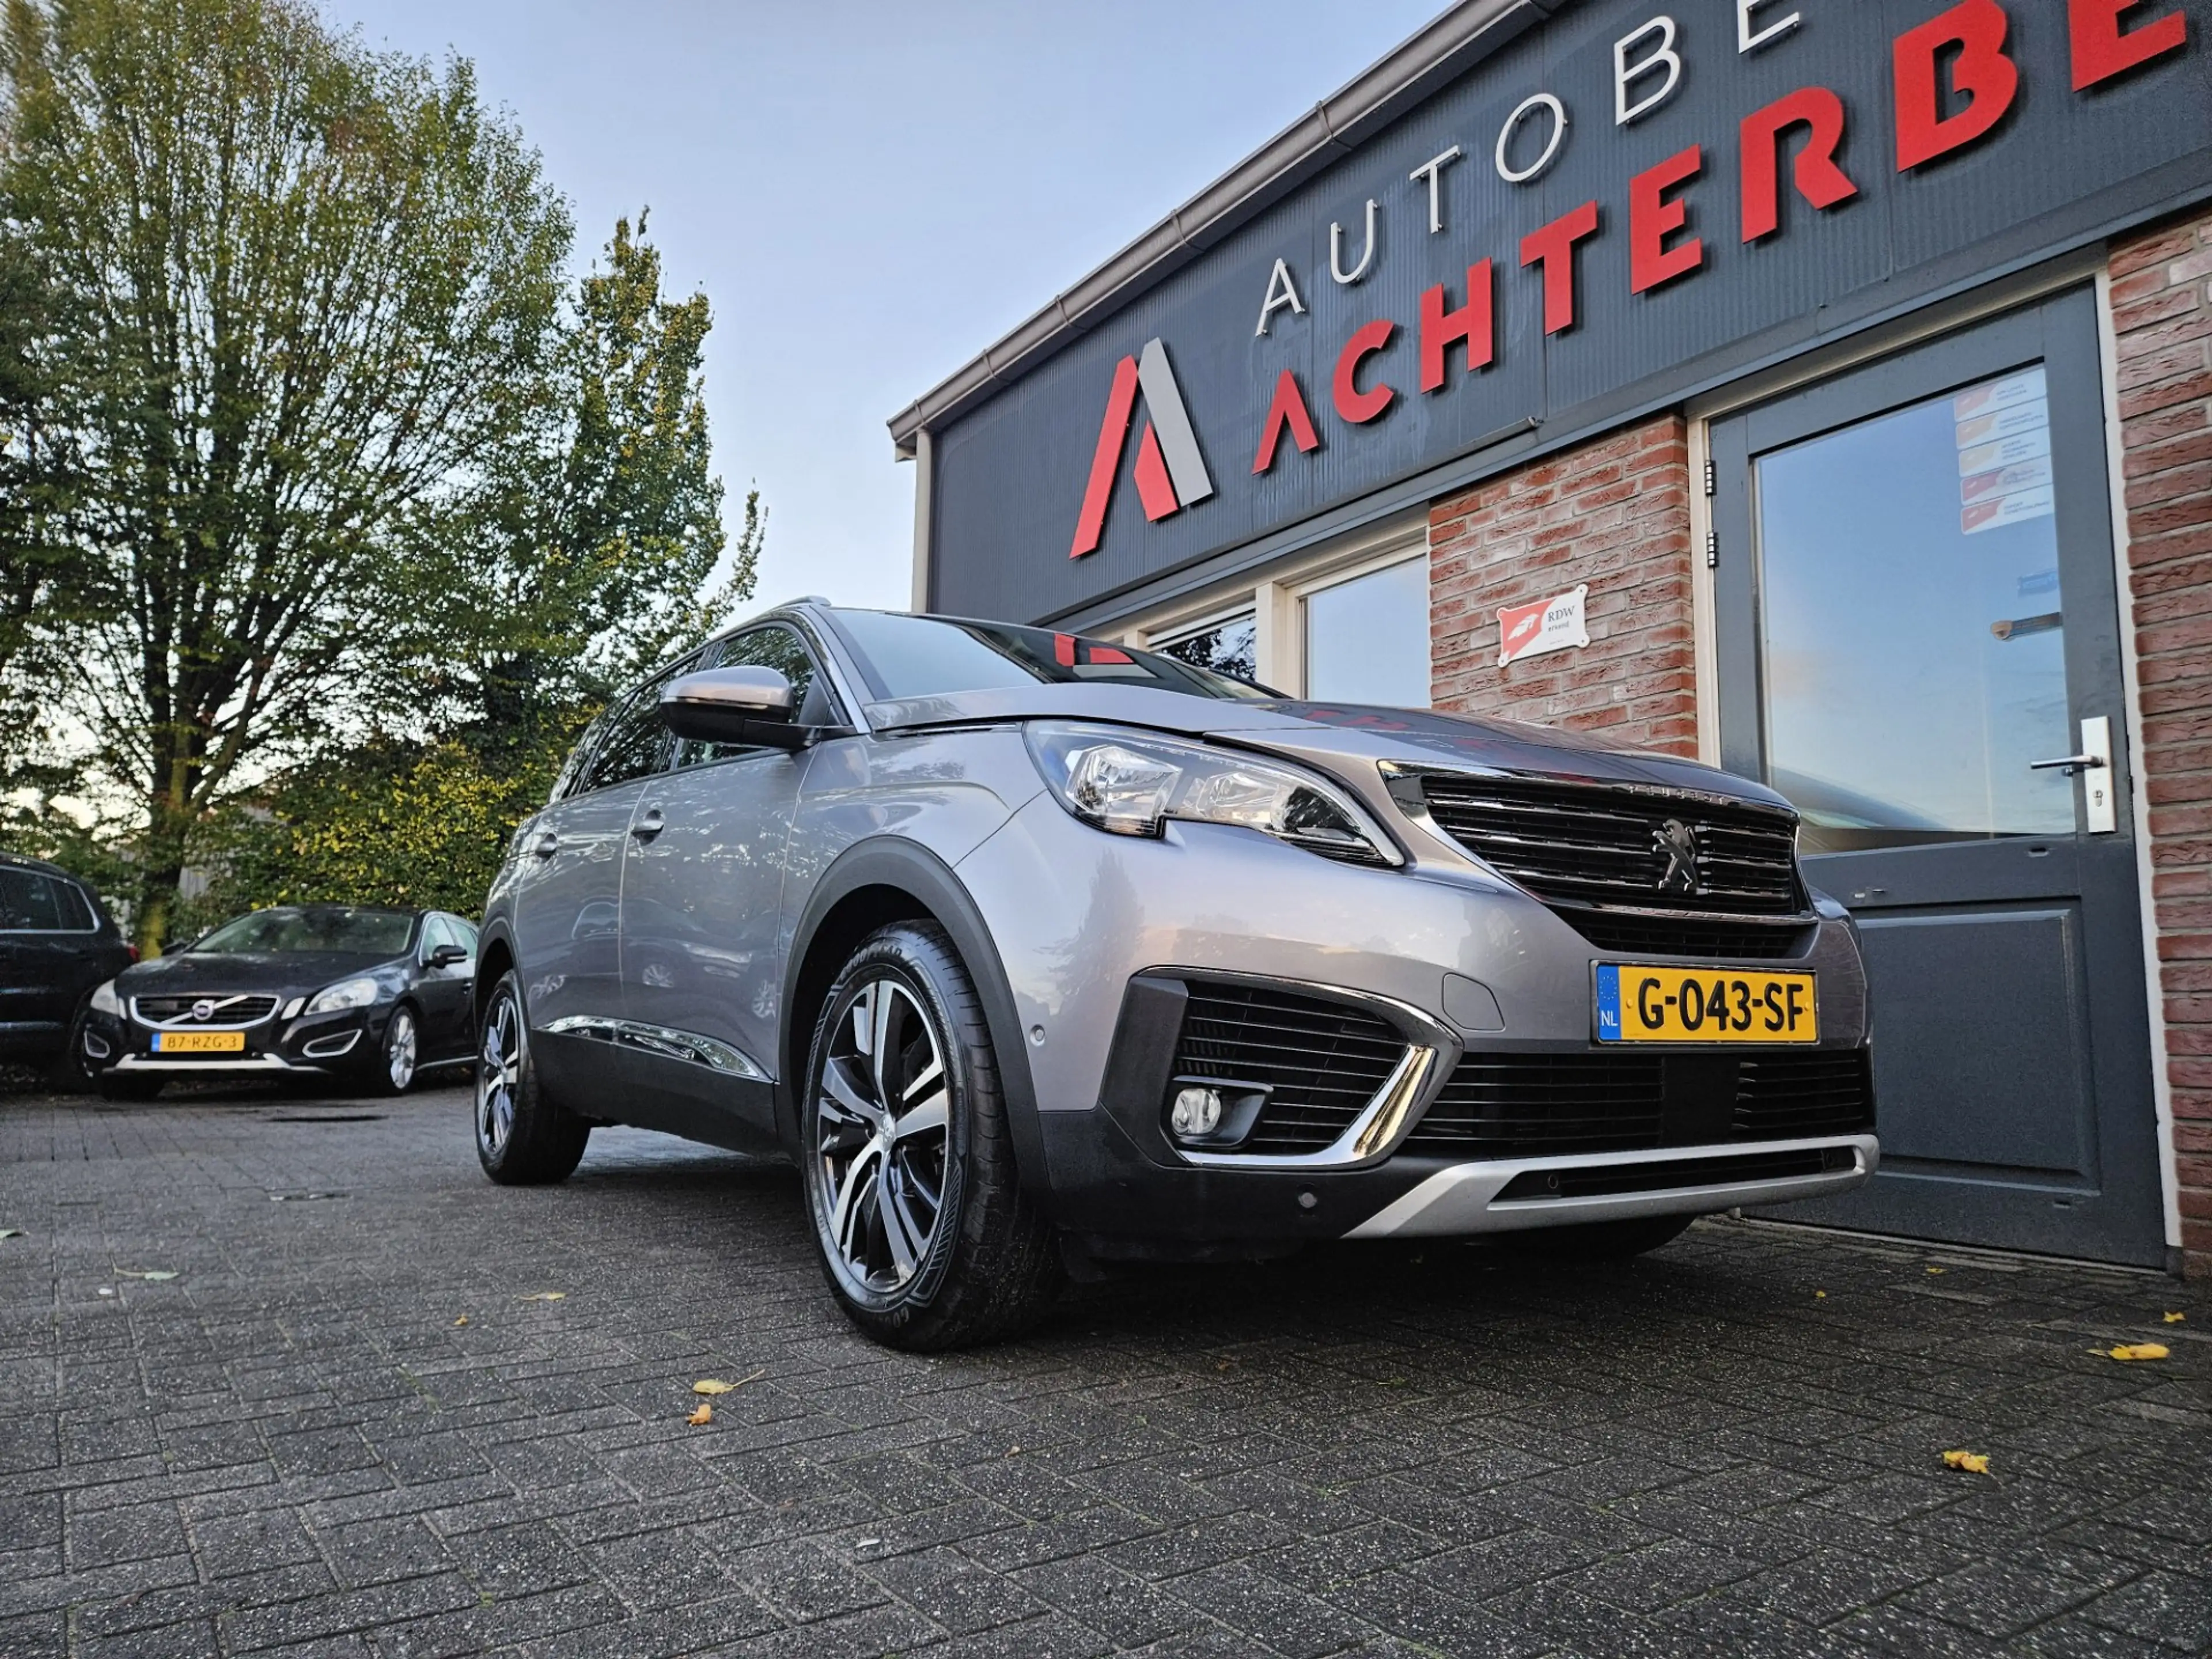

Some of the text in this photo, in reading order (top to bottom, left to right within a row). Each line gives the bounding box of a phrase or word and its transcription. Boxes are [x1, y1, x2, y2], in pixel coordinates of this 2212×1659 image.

[1548, 605, 1575, 622] RDW
[1638, 978, 1804, 1031] G-043-SF
[1601, 1010, 1618, 1027] NL
[167, 1036, 237, 1048] 87-RZG-3
